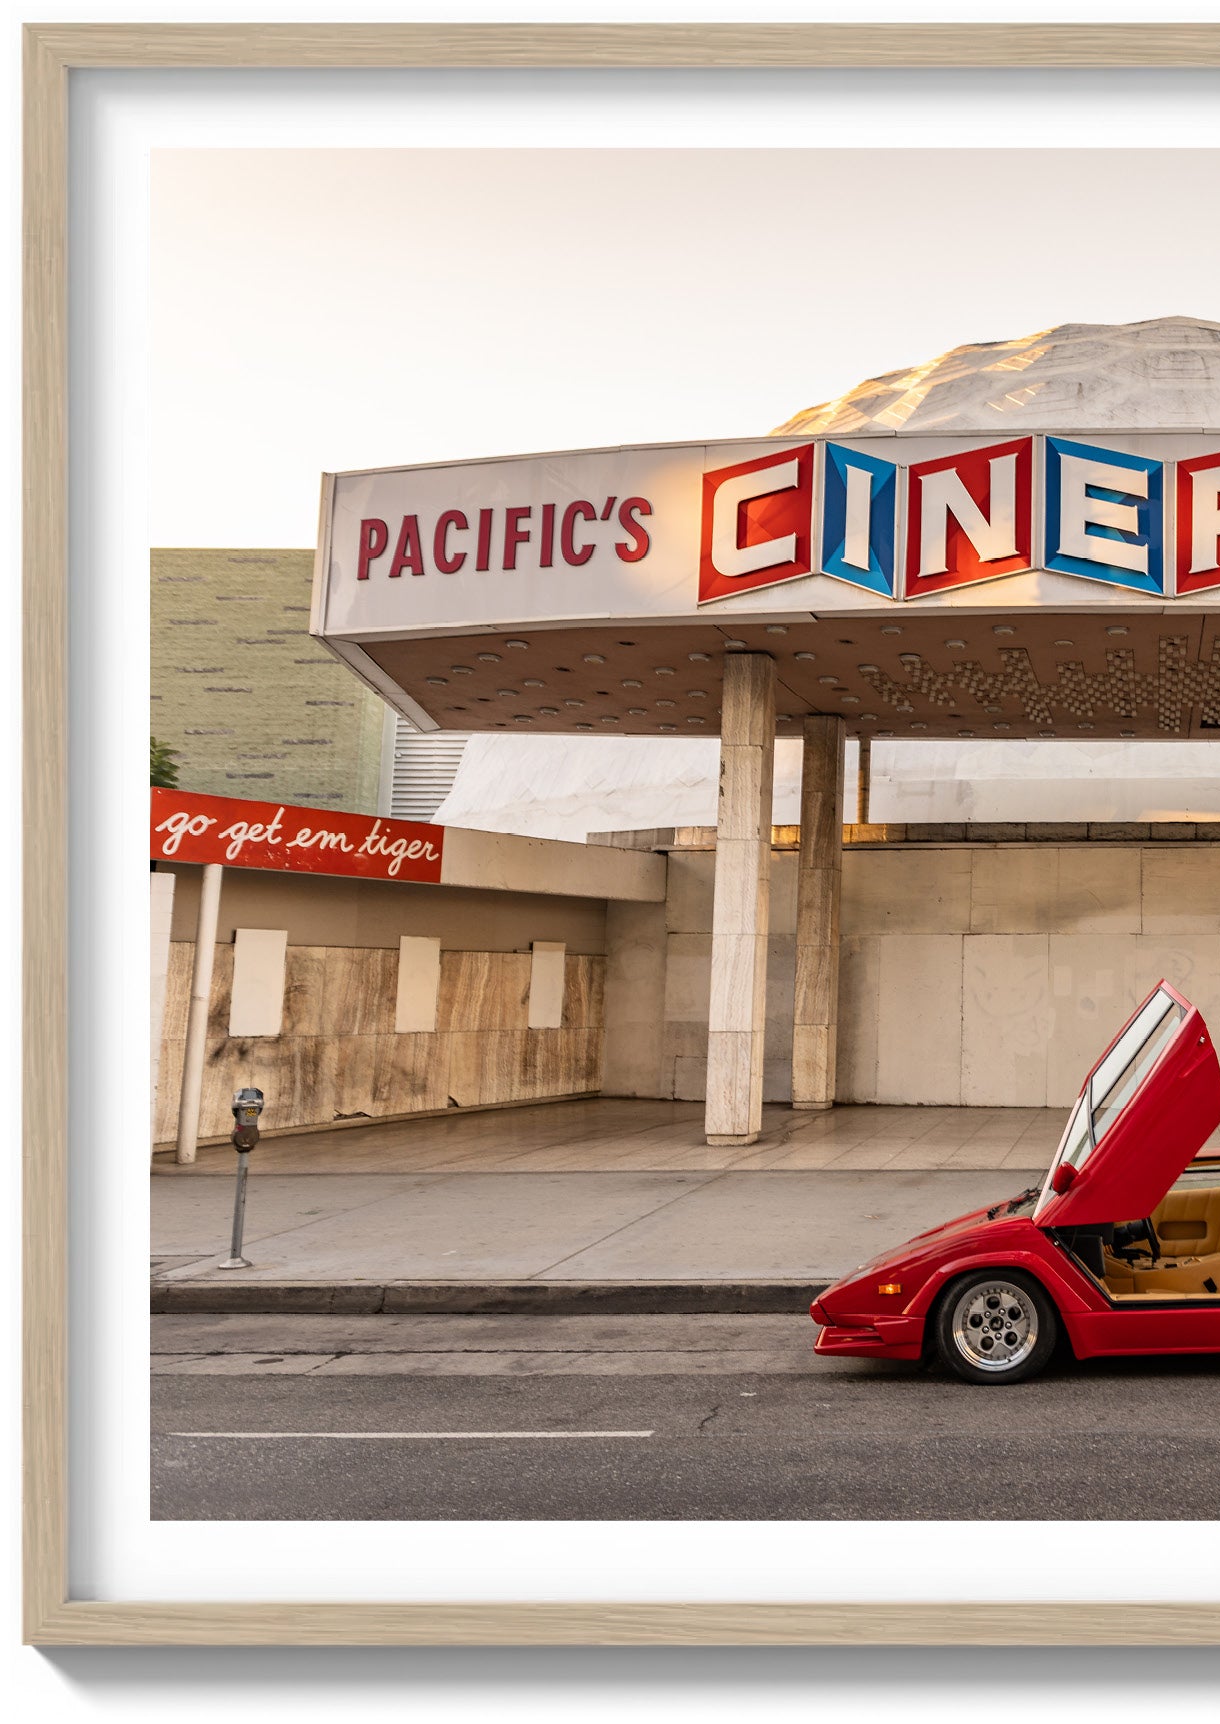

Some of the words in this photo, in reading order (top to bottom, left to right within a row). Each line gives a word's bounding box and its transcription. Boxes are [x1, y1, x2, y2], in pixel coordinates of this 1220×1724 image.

[356, 496, 654, 580] PACIFIC'S
[155, 811, 217, 856] go
[218, 806, 286, 860] get
[286, 827, 354, 853] em
[358, 818, 440, 876] tiger
